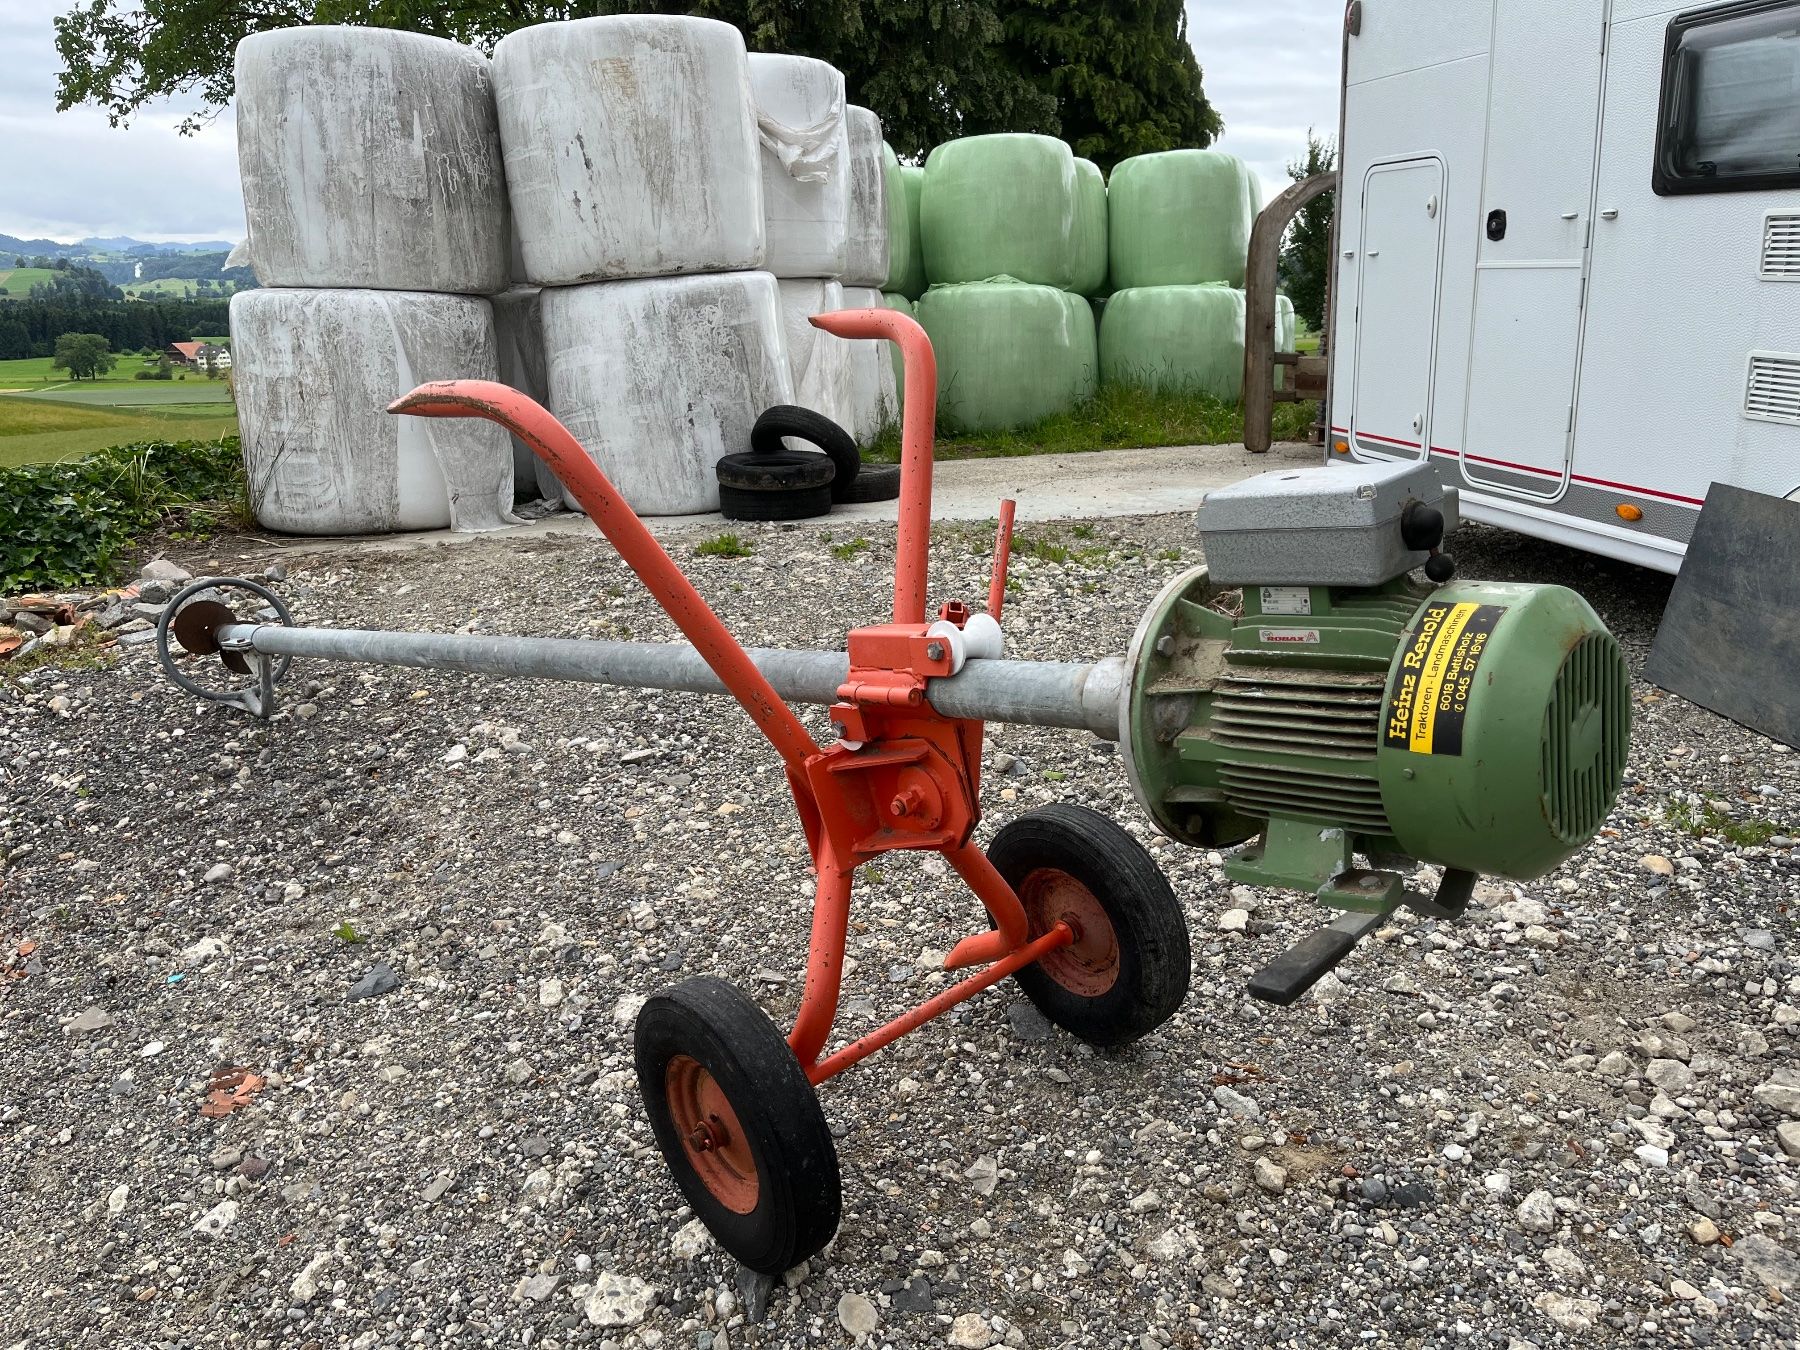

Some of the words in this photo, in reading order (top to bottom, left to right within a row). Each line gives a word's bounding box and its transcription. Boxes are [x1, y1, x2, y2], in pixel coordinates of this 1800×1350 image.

[1389, 674, 1416, 739] Heinz
[1404, 607, 1447, 669] Renold
[1416, 686, 1432, 741] Traktoren
[1427, 609, 1467, 677] Landmaschinen
[1439, 683, 1454, 711] 6018
[1447, 632, 1474, 680] Buttisholz
[1455, 677, 1470, 701] 045
[1464, 658, 1476, 672] 57
